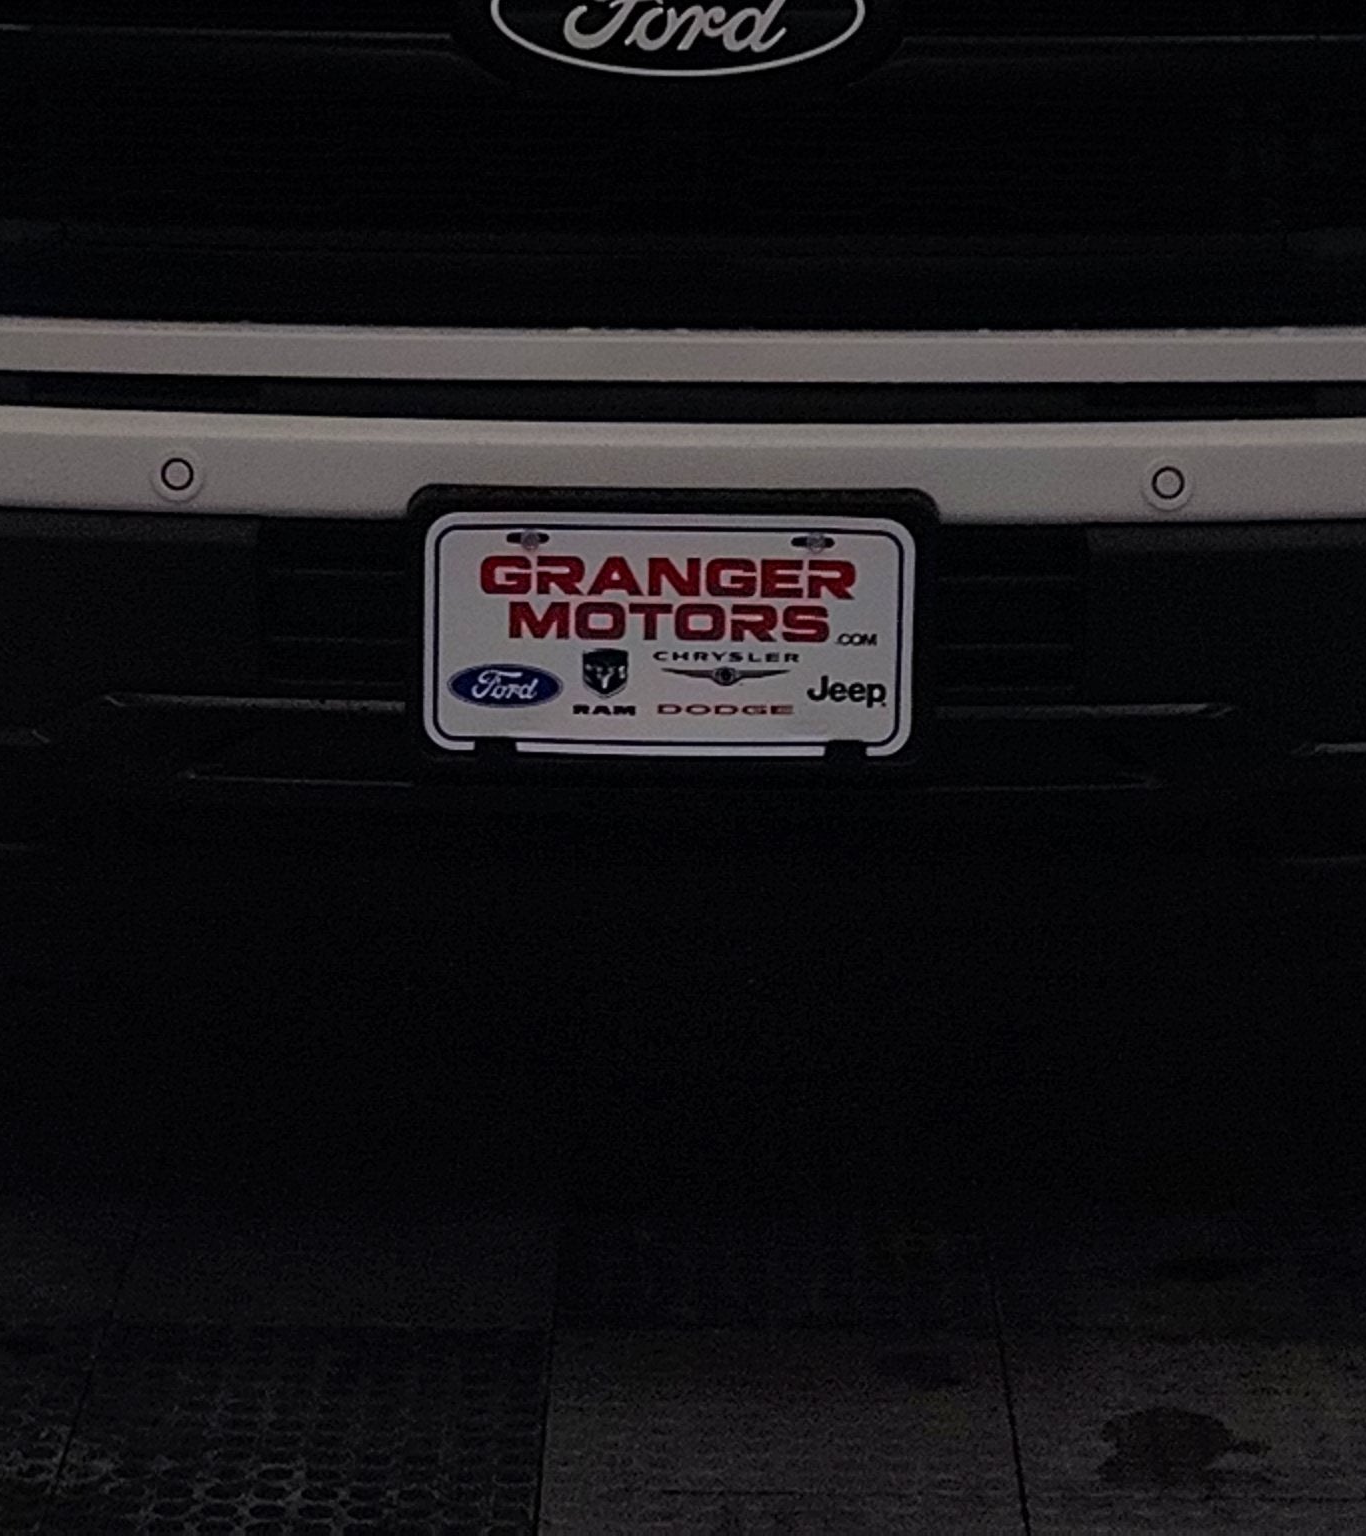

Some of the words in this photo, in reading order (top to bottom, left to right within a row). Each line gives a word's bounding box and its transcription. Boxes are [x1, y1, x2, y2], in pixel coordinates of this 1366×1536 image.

[480, 555, 857, 600] GRANGER
[508, 601, 830, 643] MOTORS
[835, 633, 878, 646] .COM
[653, 651, 800, 663] CHRYSLER
[471, 669, 539, 700] Ford
[807, 675, 887, 708] Jeep
[572, 704, 637, 716] RAM
[657, 704, 795, 715] DODGE
